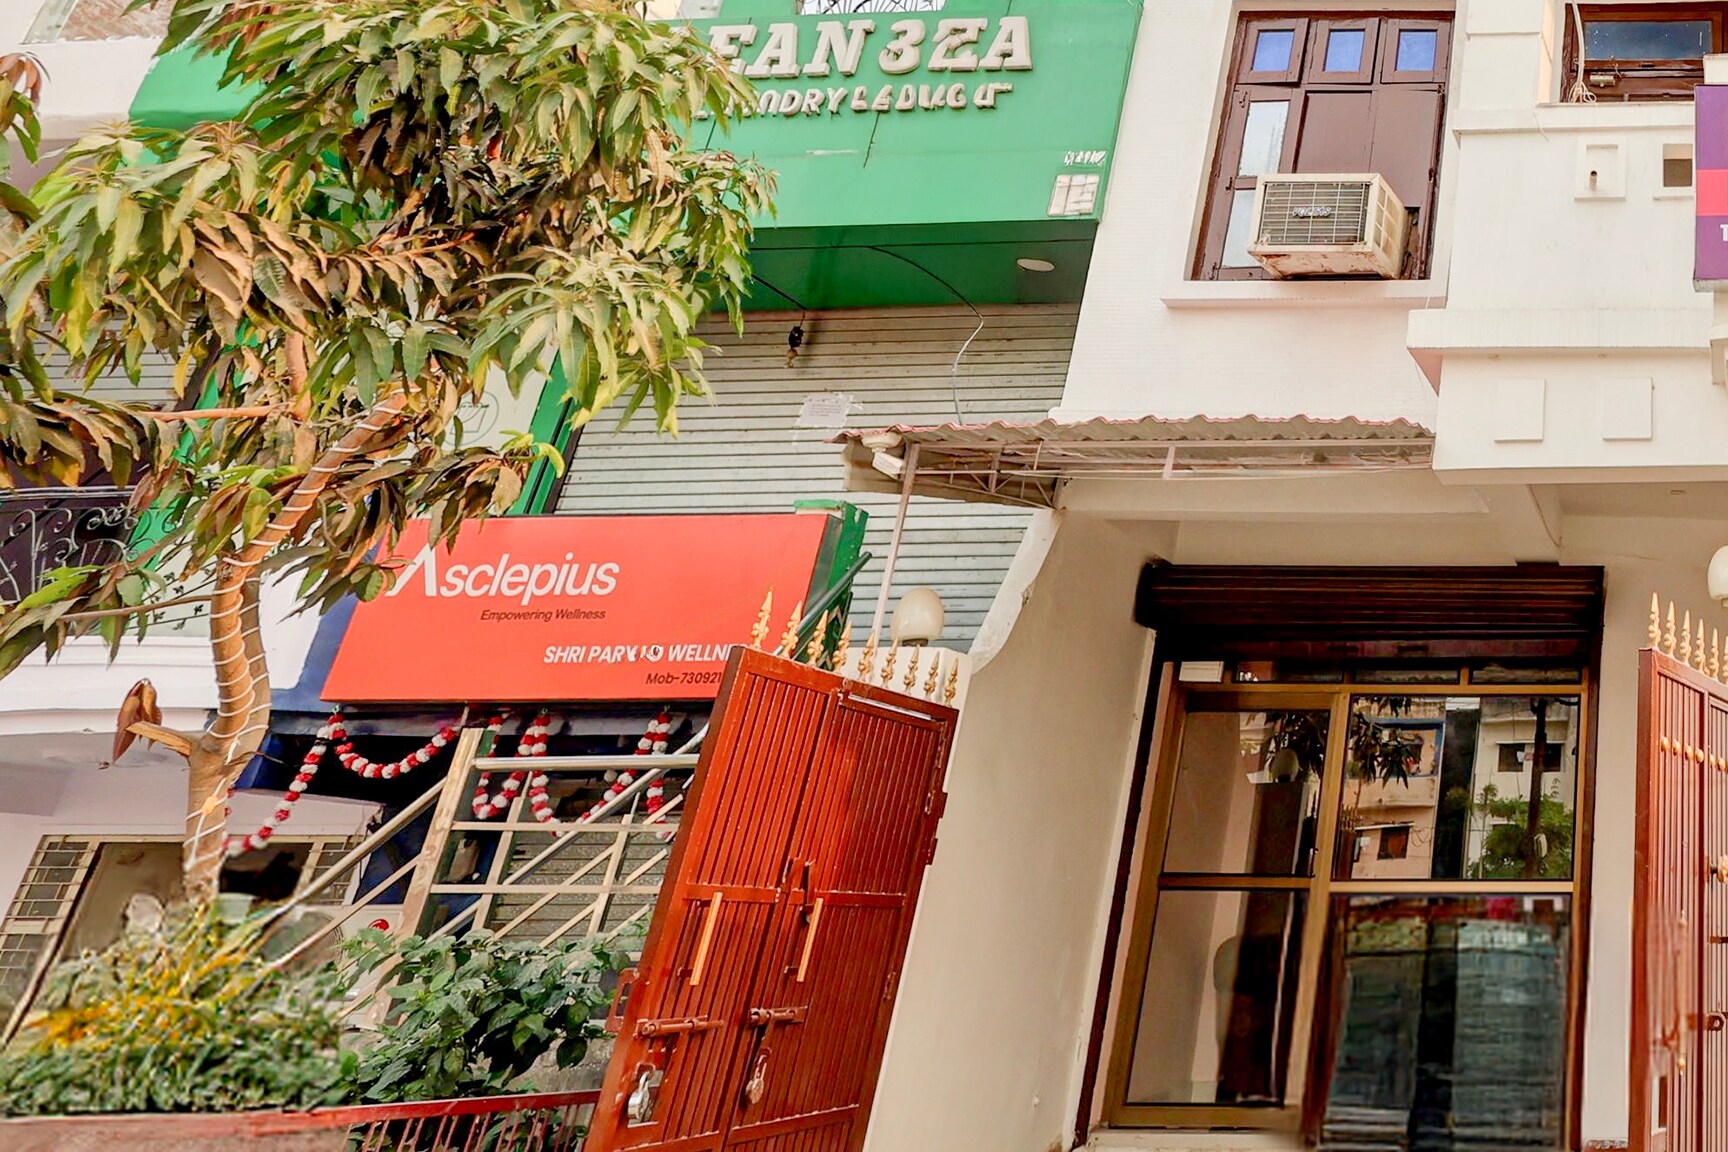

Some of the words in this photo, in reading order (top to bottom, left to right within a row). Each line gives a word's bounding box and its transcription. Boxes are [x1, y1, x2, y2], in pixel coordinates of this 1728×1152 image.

[385, 543, 620, 606] Asclepius
[481, 609, 553, 623] Empowering
[555, 608, 607, 621] Wellness
[543, 645, 587, 664] SHRI
